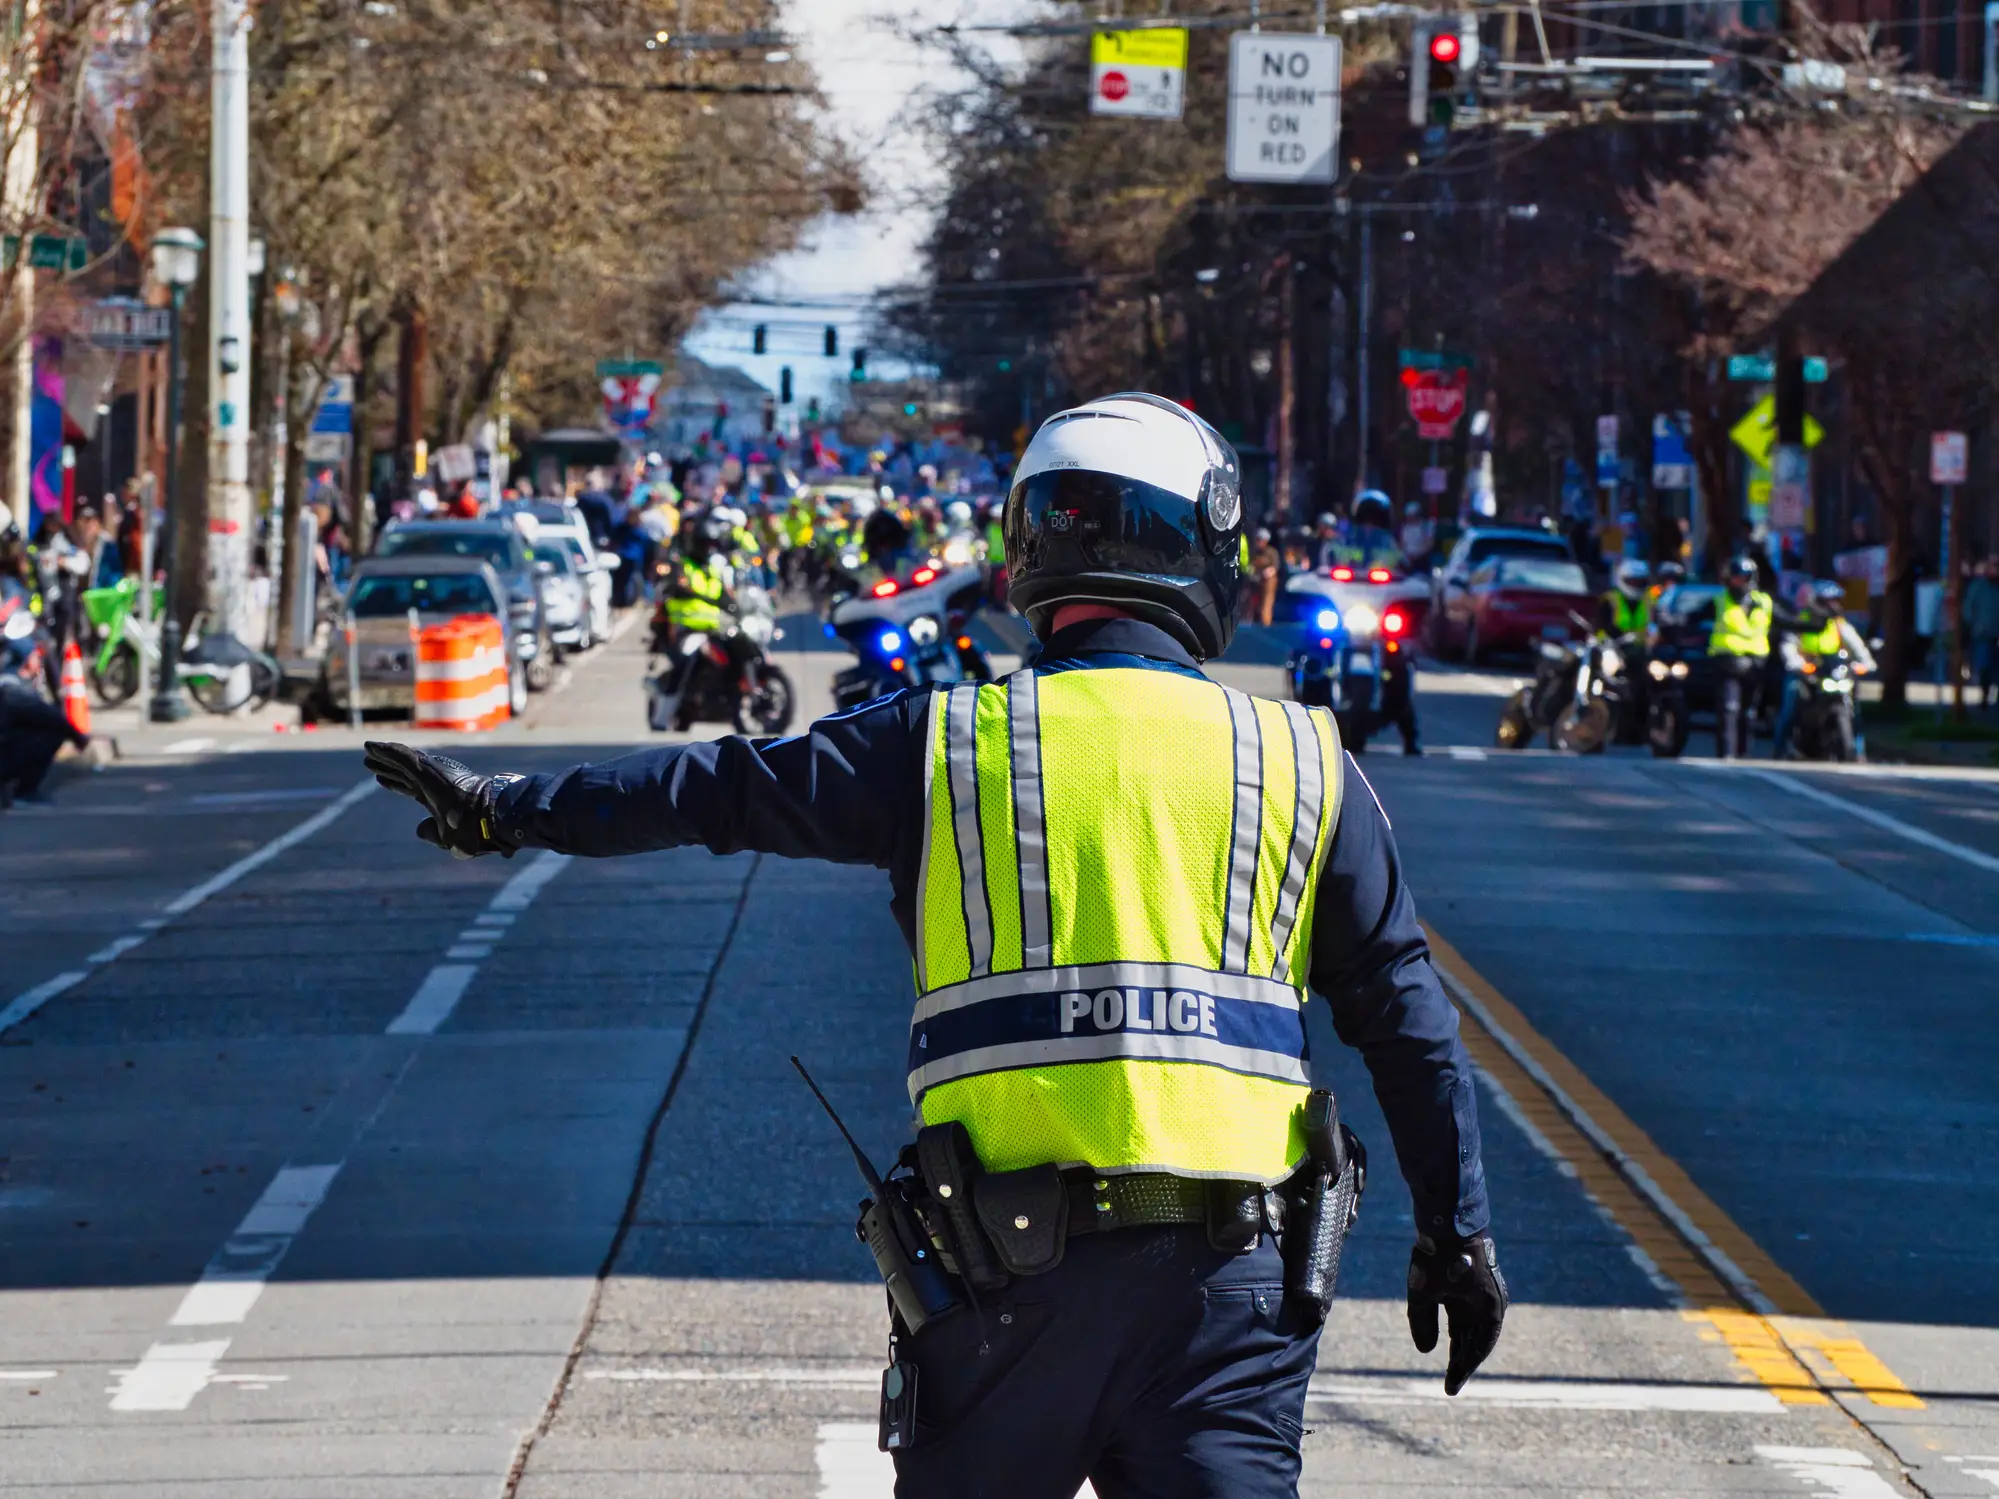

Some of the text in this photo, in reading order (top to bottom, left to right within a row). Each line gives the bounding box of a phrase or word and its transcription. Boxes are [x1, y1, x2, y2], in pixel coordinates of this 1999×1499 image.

[1262, 51, 1310, 79] NO
[1255, 85, 1315, 105] TURN
[1267, 113, 1300, 135] ON
[1259, 141, 1307, 165] RED
[1411, 387, 1460, 413] STOP
[1051, 516, 1076, 528] DOT
[1060, 989, 1219, 1037] POLICE
